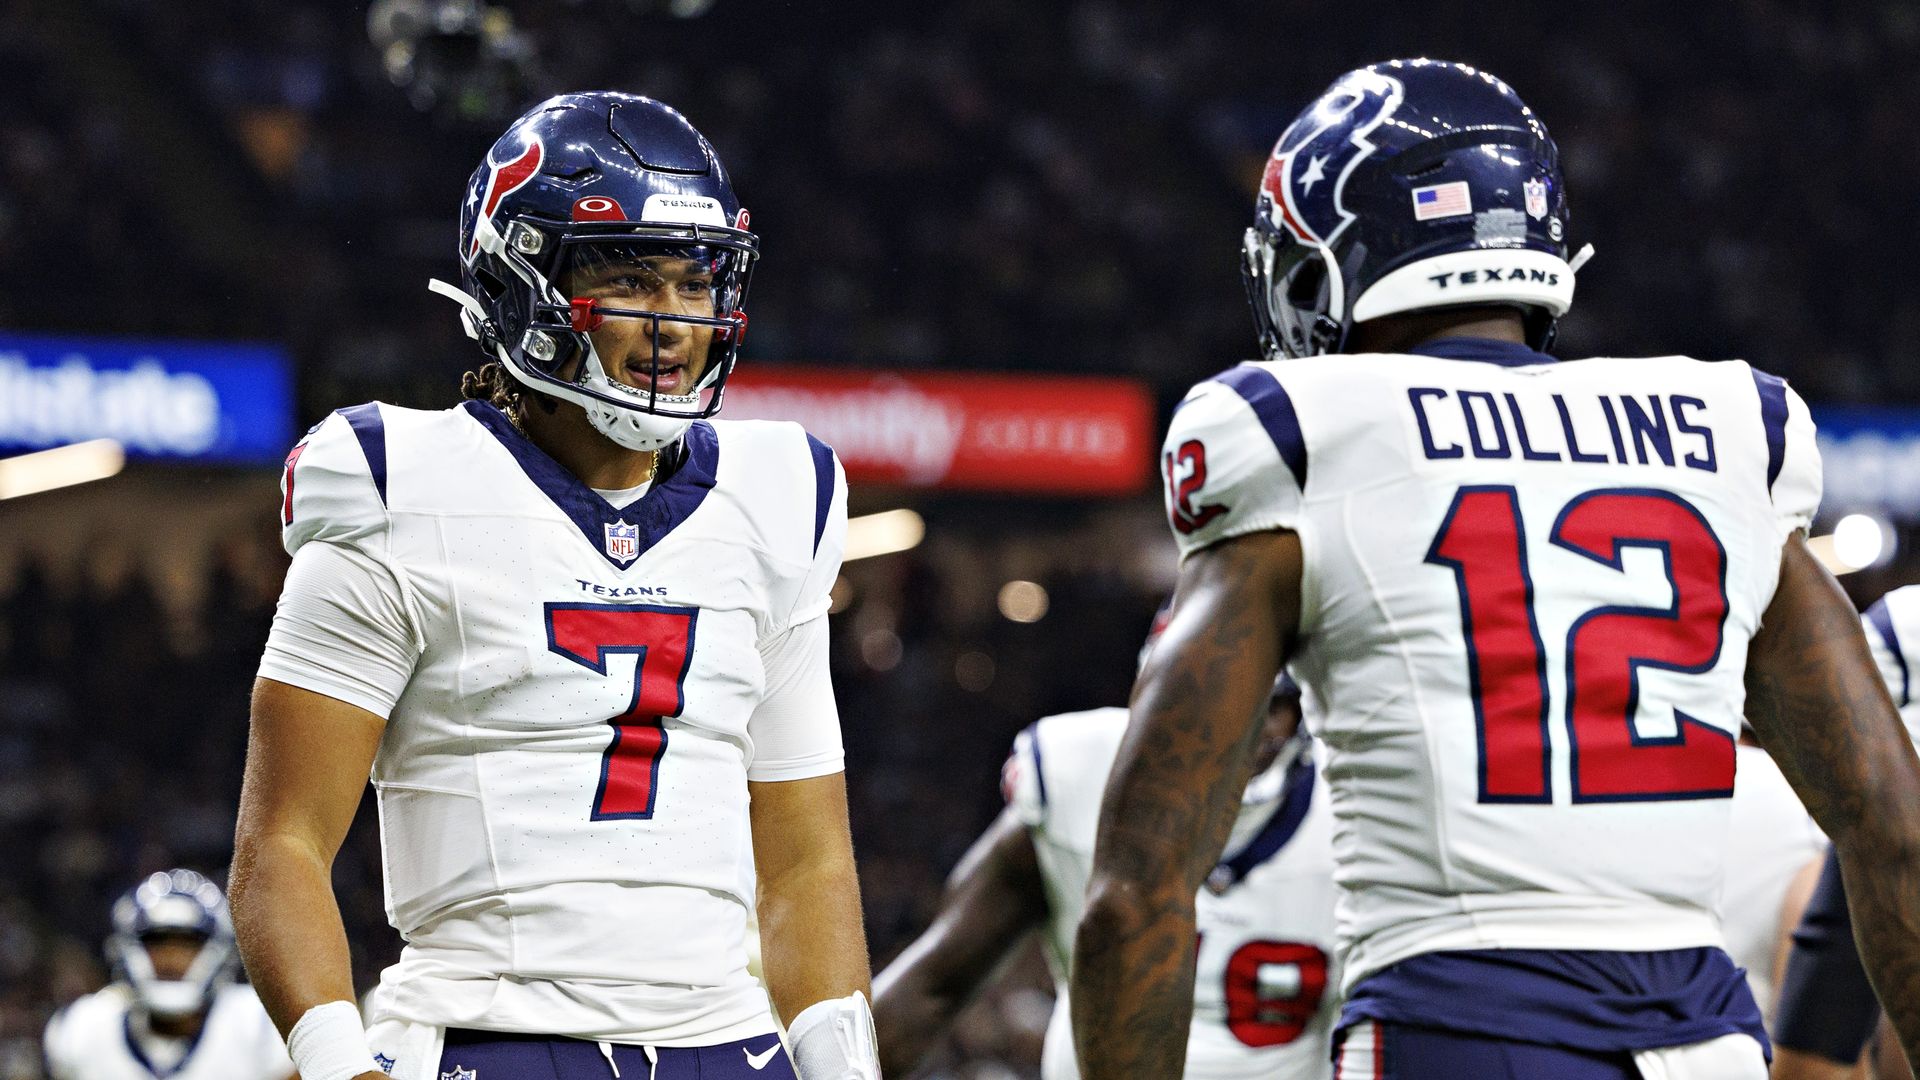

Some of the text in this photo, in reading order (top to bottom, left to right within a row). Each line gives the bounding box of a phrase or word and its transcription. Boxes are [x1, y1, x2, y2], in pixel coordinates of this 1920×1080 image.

[660, 199, 714, 209] TEXANS
[1428, 268, 1559, 288] TEXANS
[1407, 387, 1718, 473] COLLINS
[611, 539, 634, 555] NFL
[576, 579, 667, 597] TEXANS
[1423, 485, 1737, 804] 12
[543, 602, 700, 822] 7
